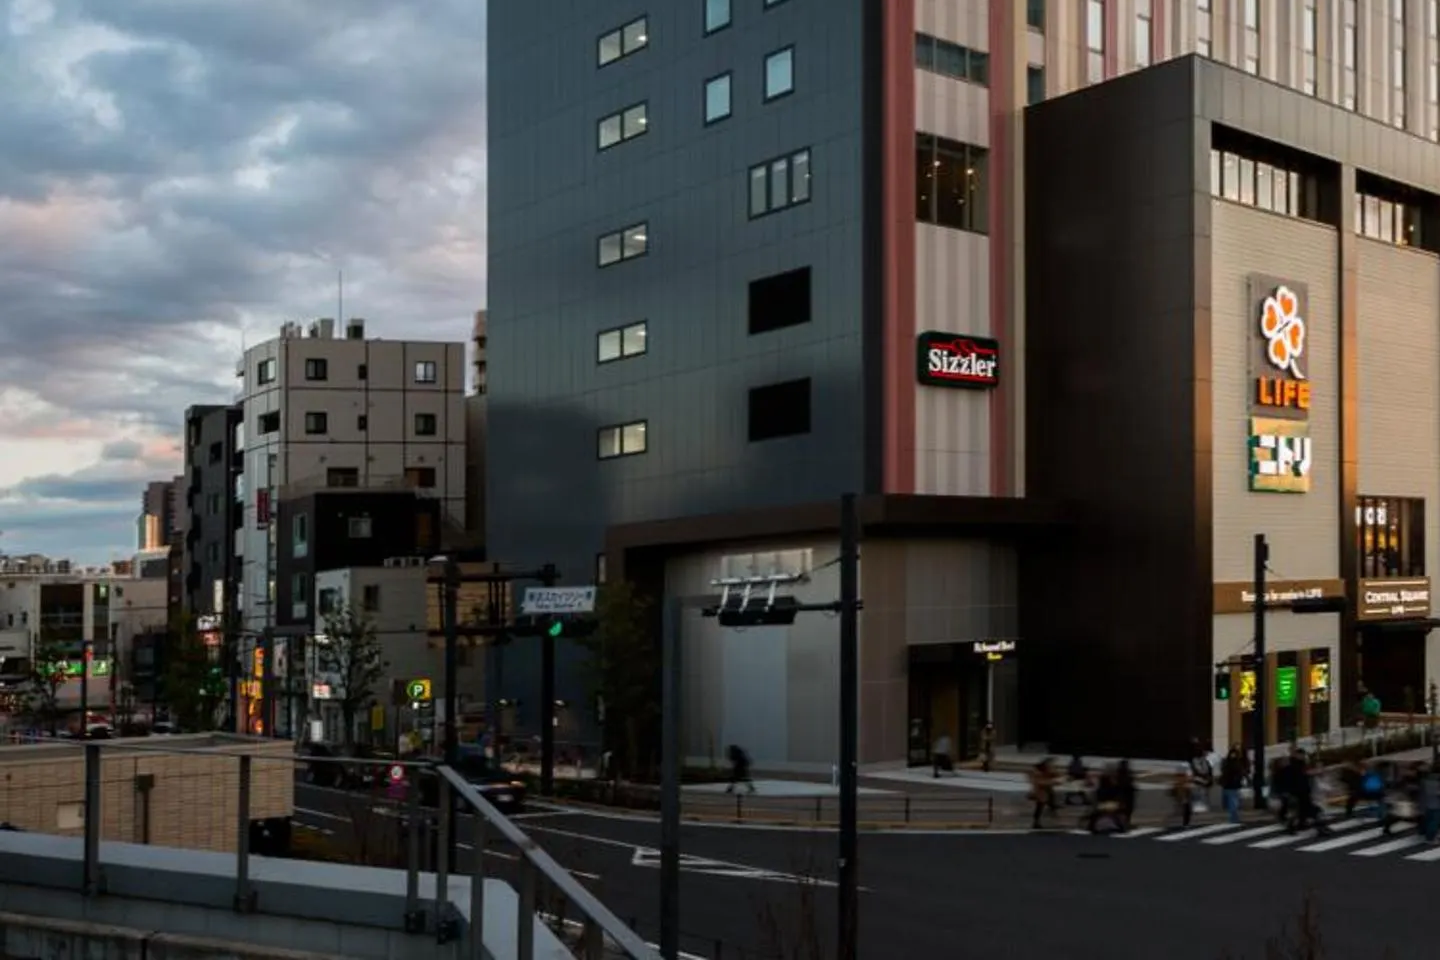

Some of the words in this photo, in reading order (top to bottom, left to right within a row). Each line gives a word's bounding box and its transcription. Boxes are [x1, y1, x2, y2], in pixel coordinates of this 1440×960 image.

[928, 348, 996, 377] Sizzler
[1258, 375, 1310, 409] LIFE
[413, 685, 423, 696] P
